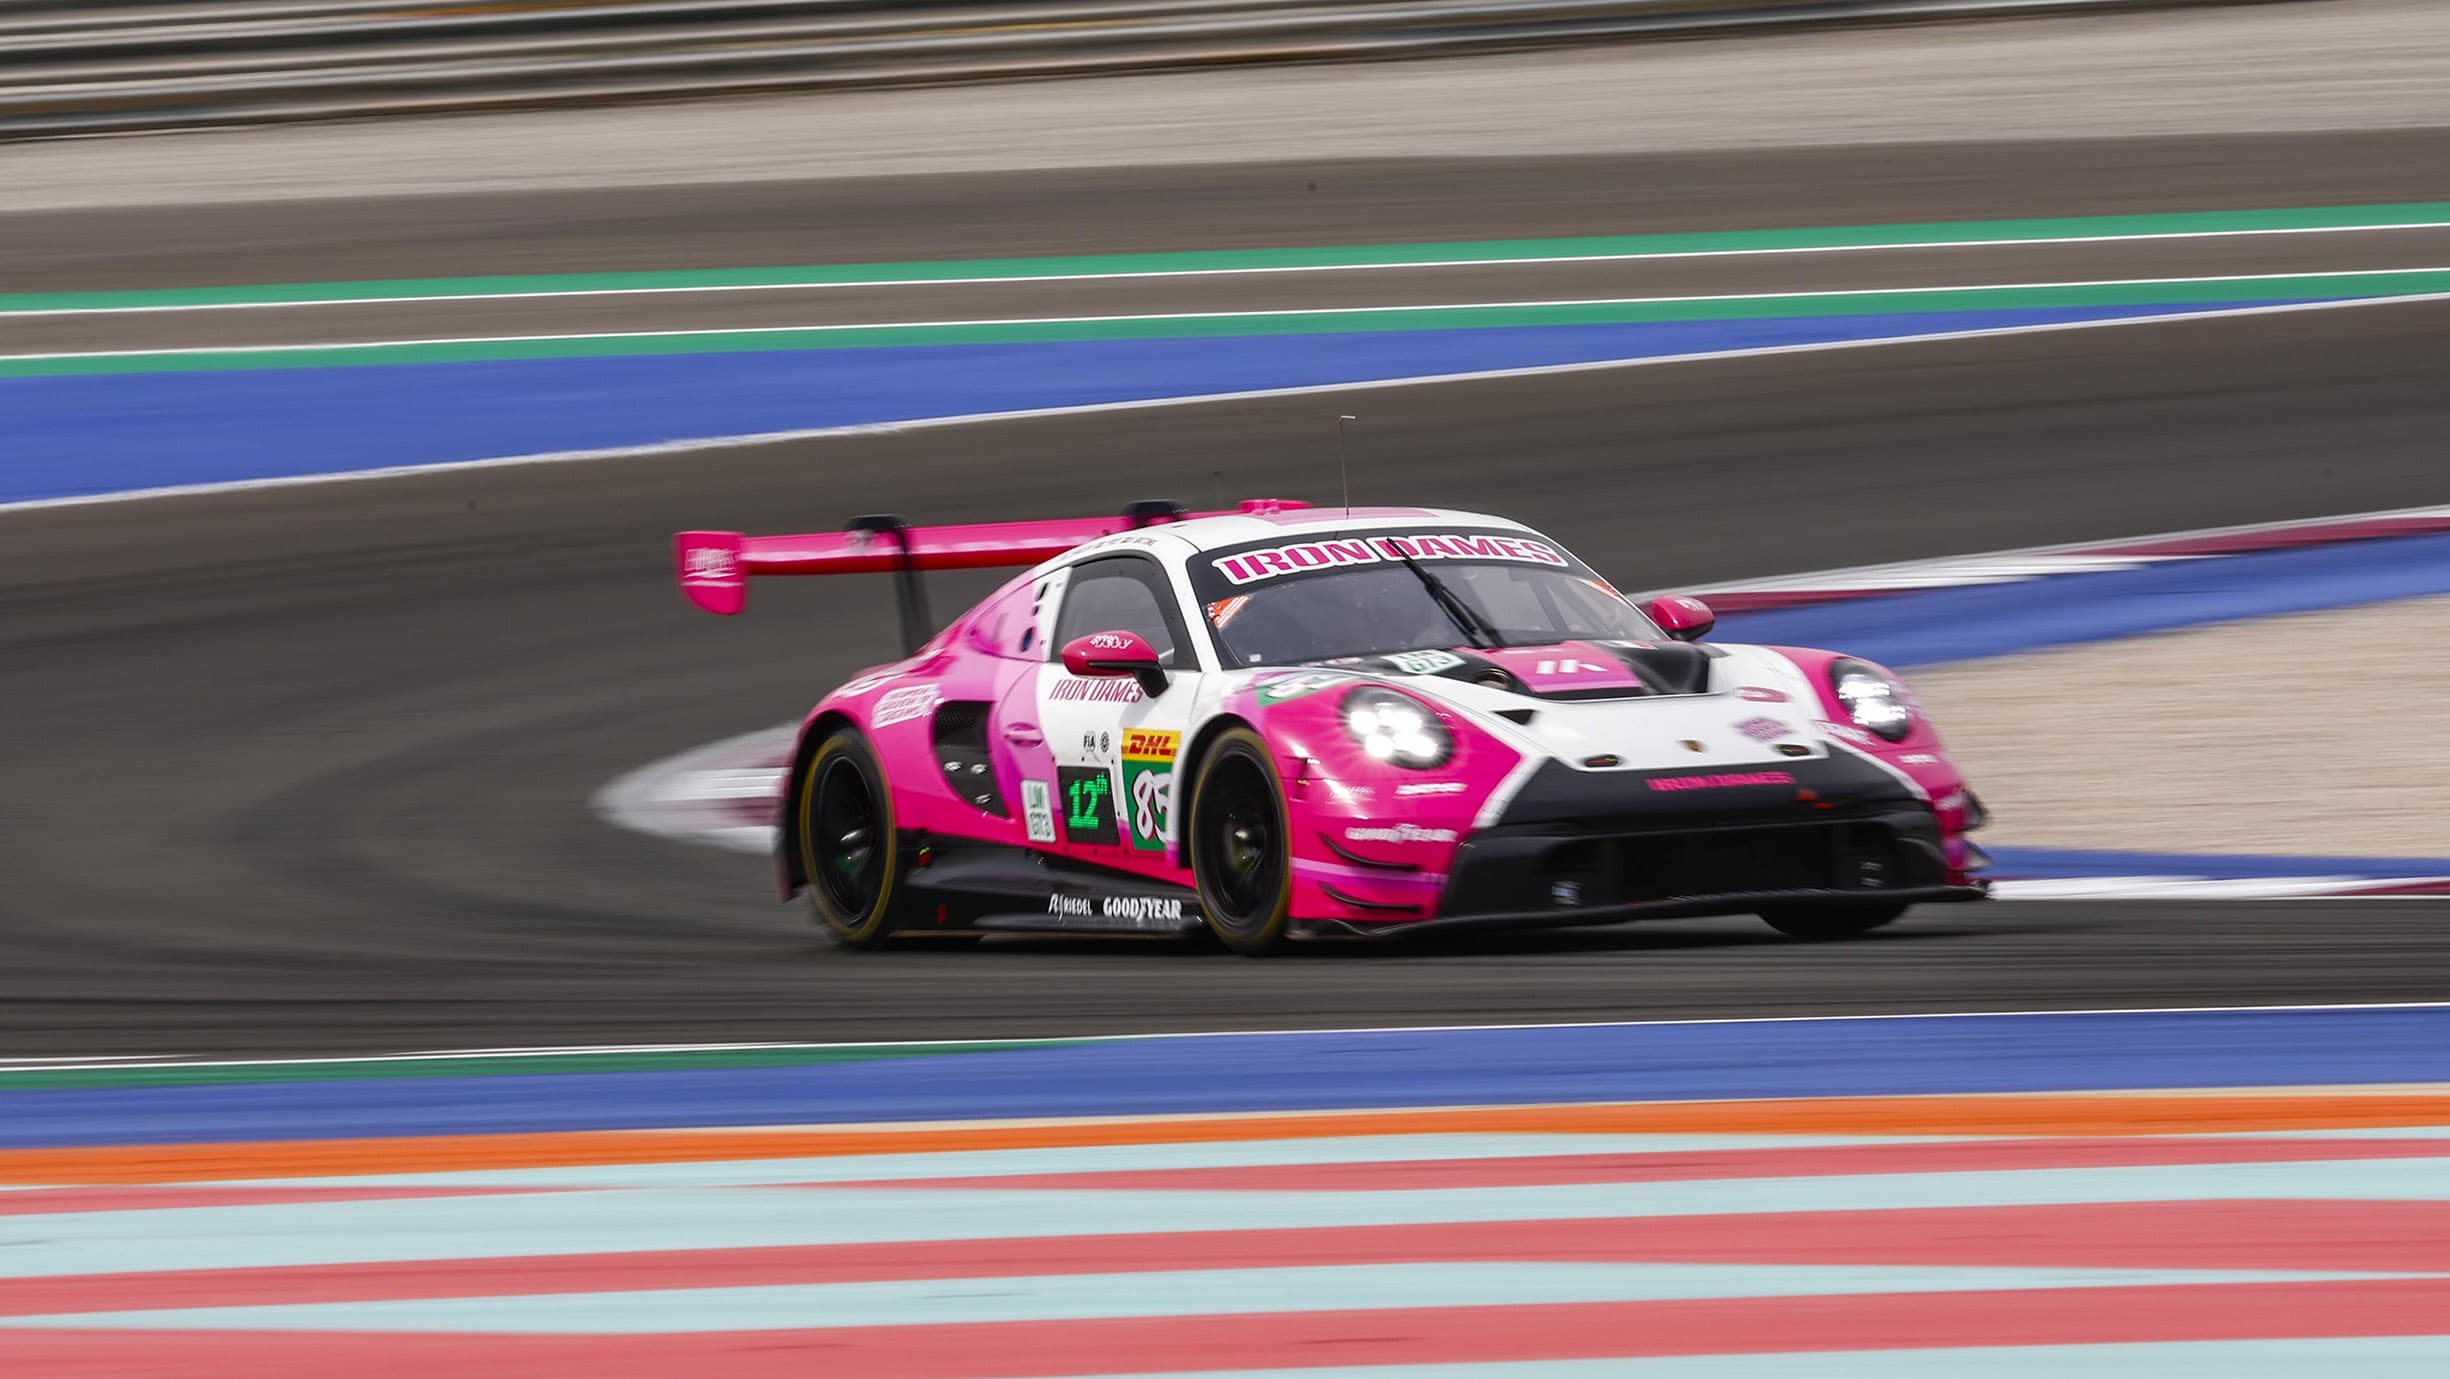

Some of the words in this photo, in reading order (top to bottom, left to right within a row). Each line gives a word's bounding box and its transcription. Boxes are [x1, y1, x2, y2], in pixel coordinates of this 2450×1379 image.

[1217, 539, 1379, 582] IRON
[1371, 536, 1565, 566] DAMES
[1049, 679, 1091, 701] IRON
[1088, 679, 1143, 704] DAMES
[1083, 735, 1096, 749] FIA
[1129, 734, 1172, 756] DHL
[1103, 896, 1182, 922] GOODYEAR
